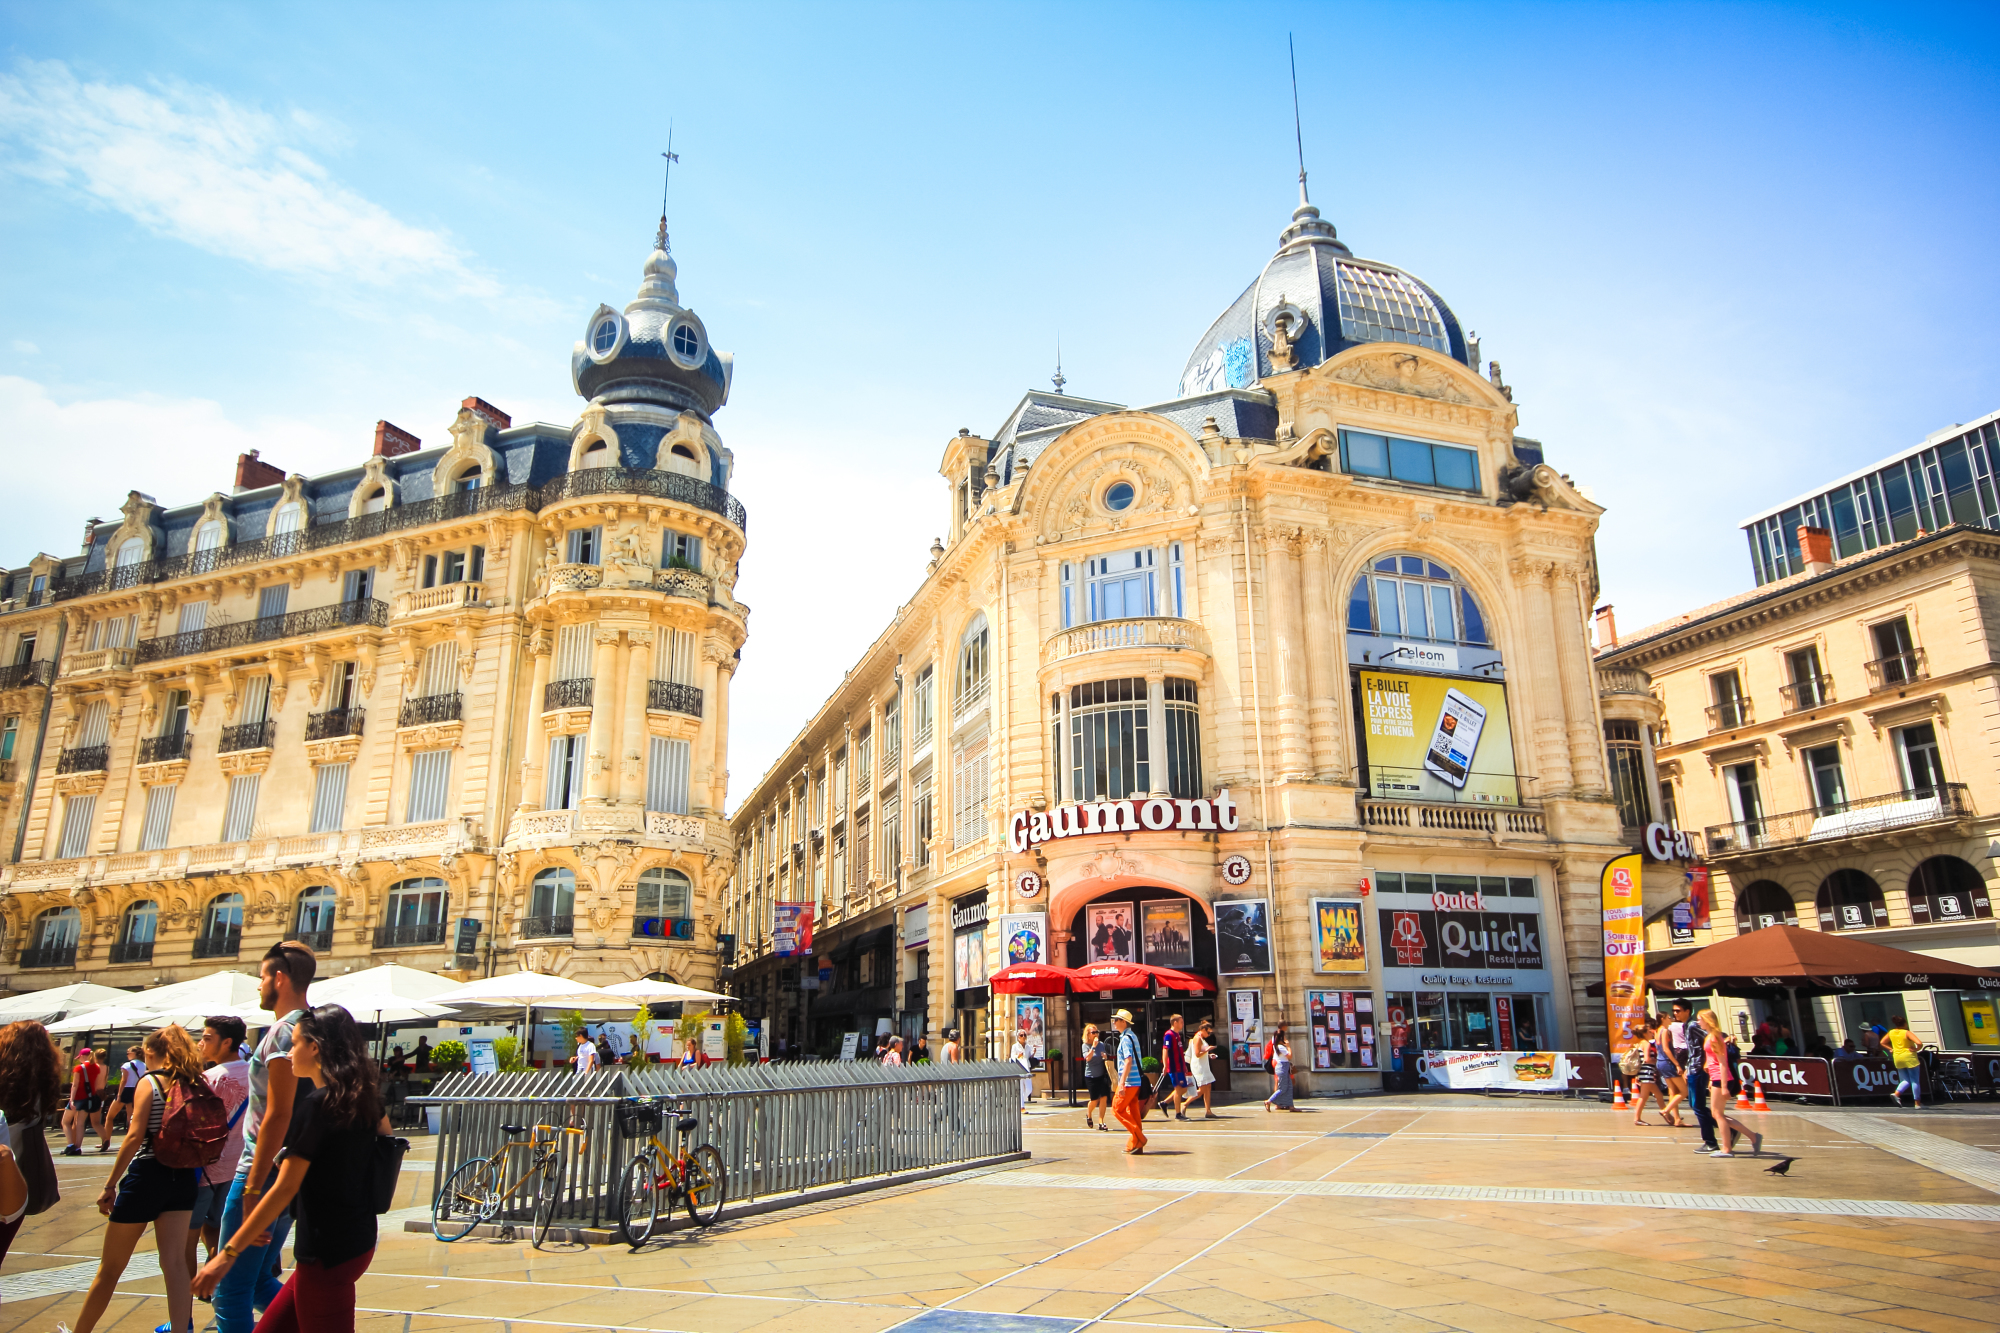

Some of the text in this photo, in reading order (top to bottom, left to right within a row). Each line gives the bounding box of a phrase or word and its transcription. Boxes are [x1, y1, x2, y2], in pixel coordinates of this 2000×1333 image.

[1409, 660, 1445, 668] avocats
[1366, 678, 1409, 693] E-BILLET
[1368, 690, 1412, 708] LA VOIE
[1369, 705, 1413, 720] EXPRESS
[1370, 717, 1382, 725] POUR
[1383, 718, 1396, 726] VOTRE
[1371, 724, 1415, 737] DE CINEMA
[1009, 788, 1239, 854] Gaumont
[1228, 862, 1244, 878] G
[1021, 877, 1035, 891] G
[1360, 880, 1366, 888] Q
[1615, 871, 1629, 886] Q
[1432, 891, 1488, 912] Quick
[950, 902, 989, 929] Gaumo
[1320, 908, 1359, 928] MAD
[1618, 911, 1640, 919] LUNDIS
[643, 918, 690, 938] CIC
[1007, 920, 1040, 934] VICE VERSA
[1398, 917, 1419, 943] Q
[1322, 928, 1361, 948] MAX
[1441, 920, 1539, 958] Quick
[1606, 942, 1642, 956] OUF!
[1091, 966, 1119, 976] Comédie
[1422, 974, 1514, 985] Quality Burger Restaurant
[1674, 978, 1700, 990] Quick
[1752, 977, 1783, 986] Quick
[1833, 976, 1859, 987] Quick
[1904, 974, 1929, 985] Quick
[1499, 999, 1507, 1010] Q
[1610, 1003, 1644, 1011] Tous les
[1391, 1009, 1407, 1028] Q
[1614, 1021, 1634, 1039] à 5
[1393, 1047, 1400, 1055] Q
[1428, 1059, 1447, 1069] Plaisir
[1448, 1053, 1470, 1065] illimité
[1470, 1052, 1482, 1062] pour
[1469, 1062, 1481, 1070] Menu
[1480, 1059, 1499, 1067] Smart
[1738, 1062, 1808, 1086] Quick
[1853, 1064, 1899, 1092] Quic
